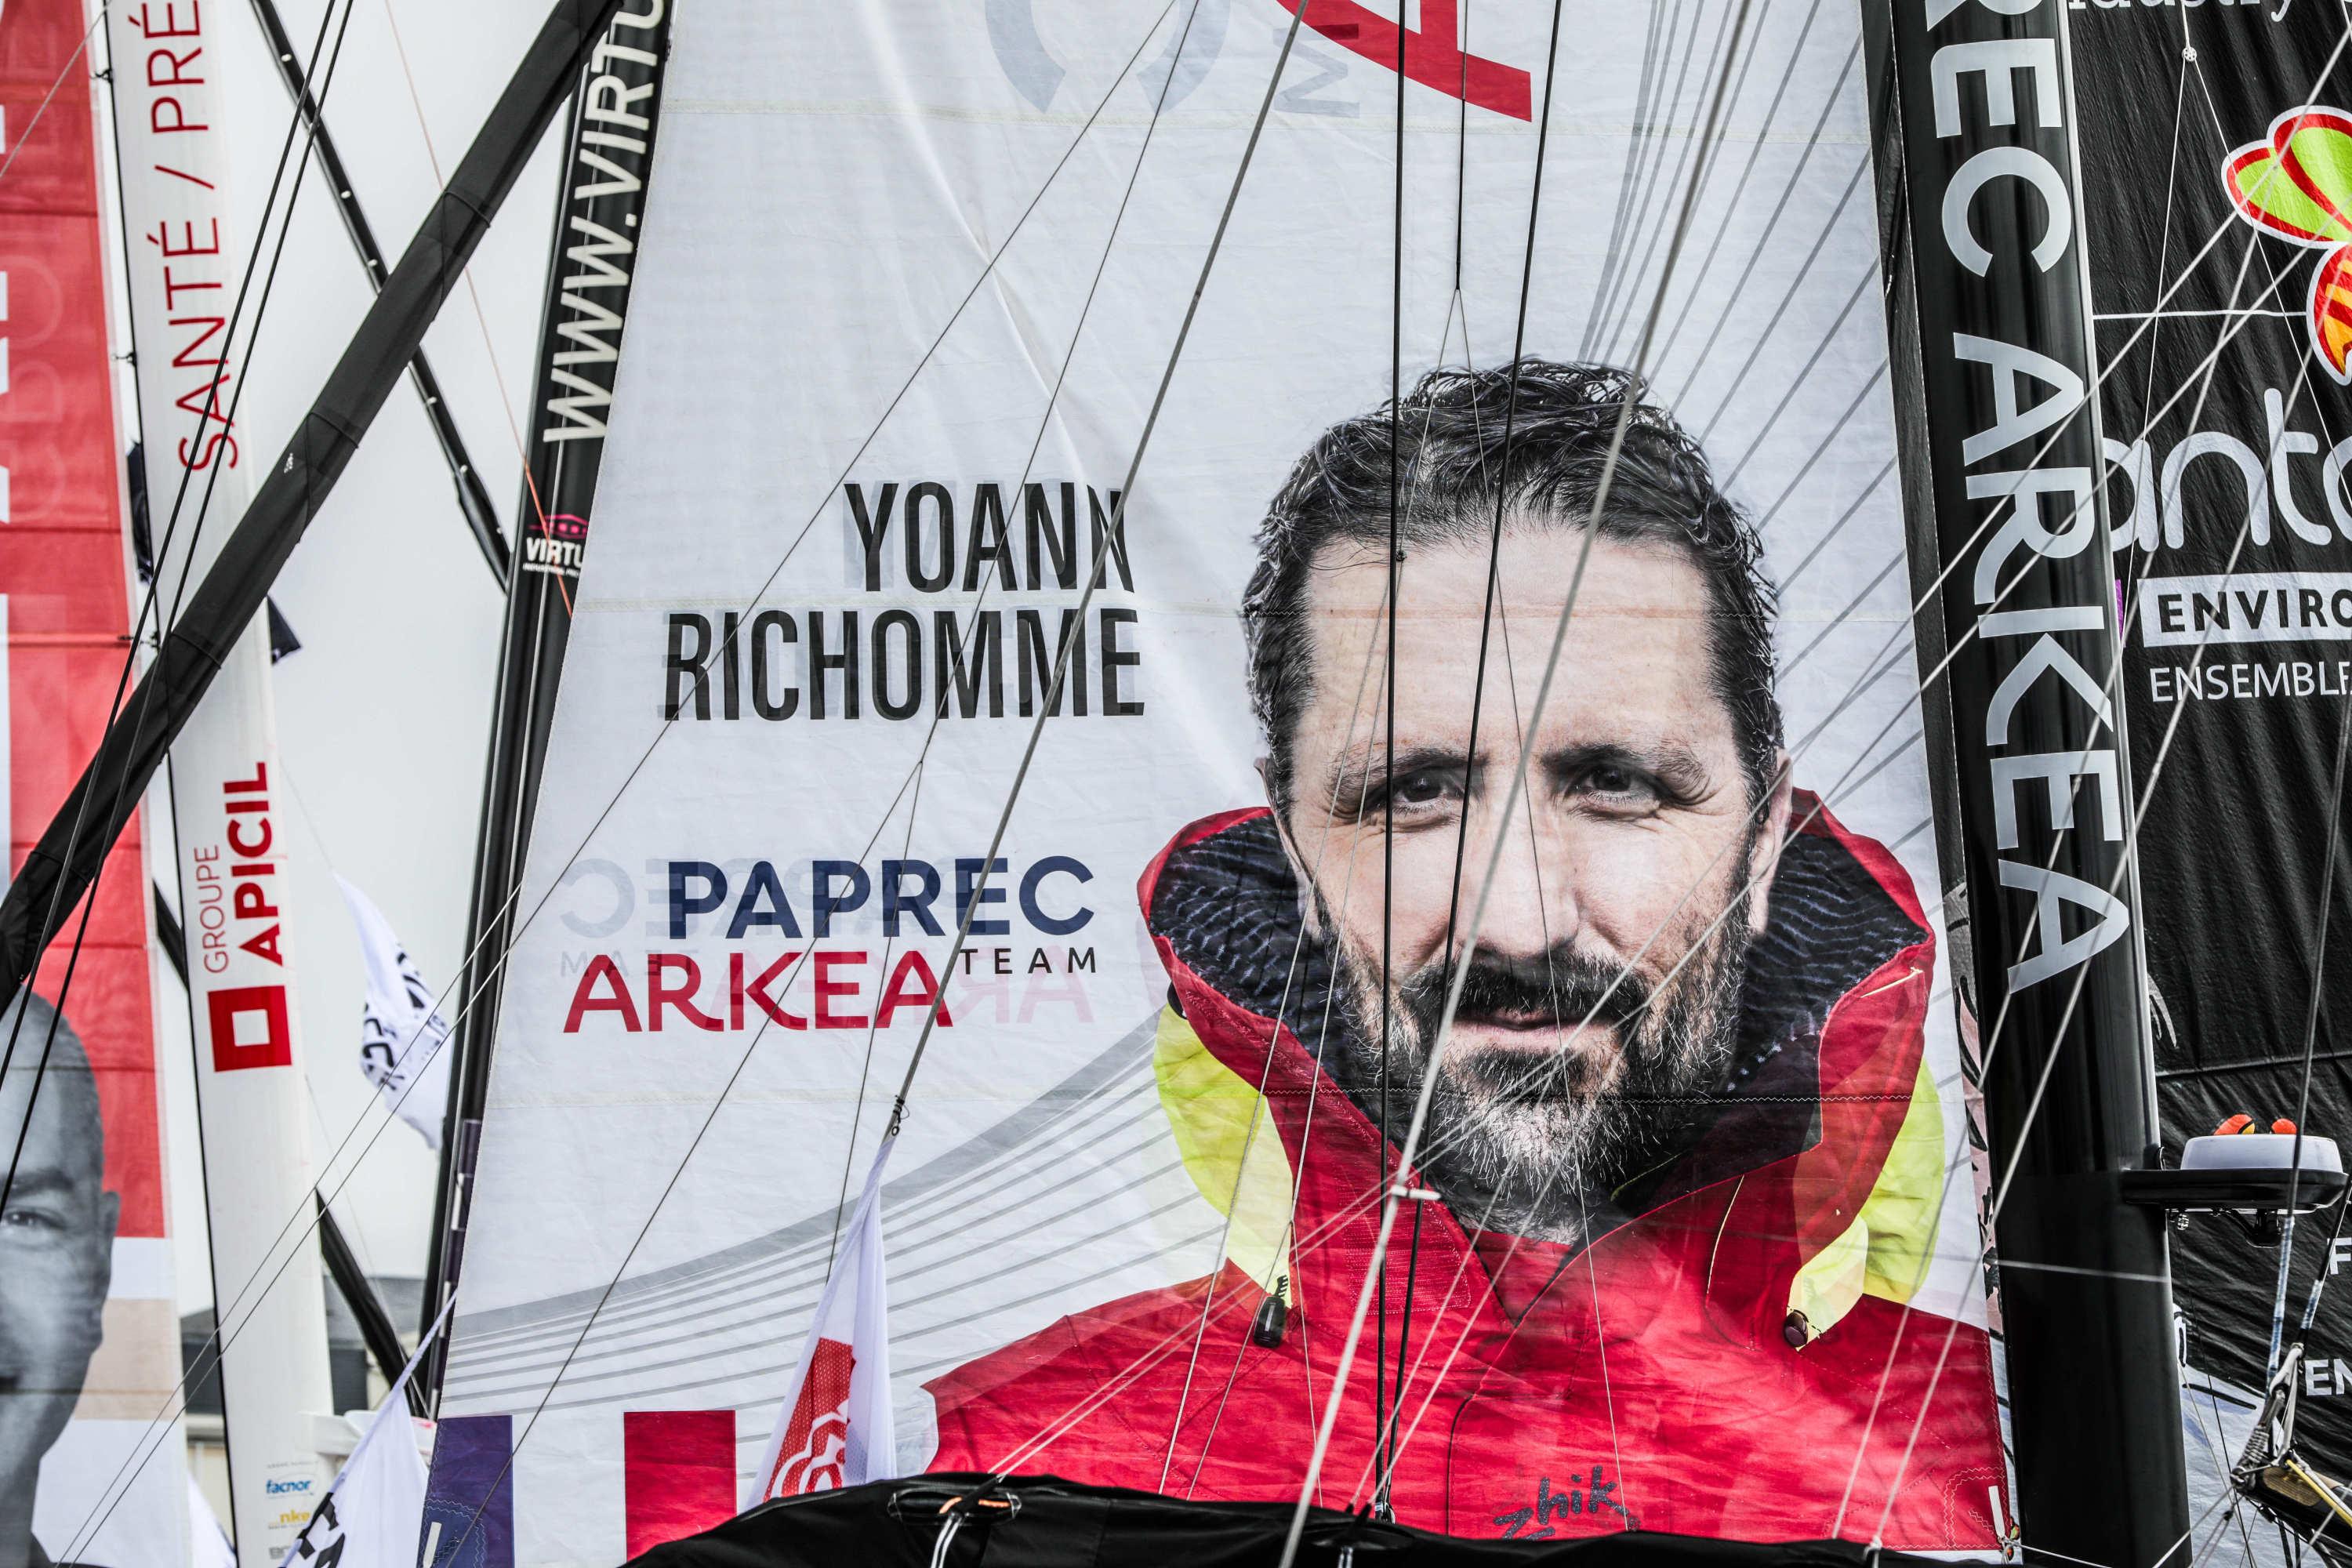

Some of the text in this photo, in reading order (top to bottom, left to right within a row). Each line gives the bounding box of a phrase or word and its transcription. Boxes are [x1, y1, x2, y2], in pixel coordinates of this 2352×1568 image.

[147, 217, 238, 472] SANTÉ
[844, 481, 1135, 593] YOANN
[663, 608, 1145, 721] RICHOMME
[1953, 332, 2130, 994] ARKEA
[194, 844, 229, 975] GROUPE
[223, 761, 283, 966] APICIL
[668, 856, 1094, 939] PAPREC
[564, 950, 953, 1033] ARKEA
[961, 946, 1098, 975] TEAM
[266, 1479, 311, 1494] facnor
